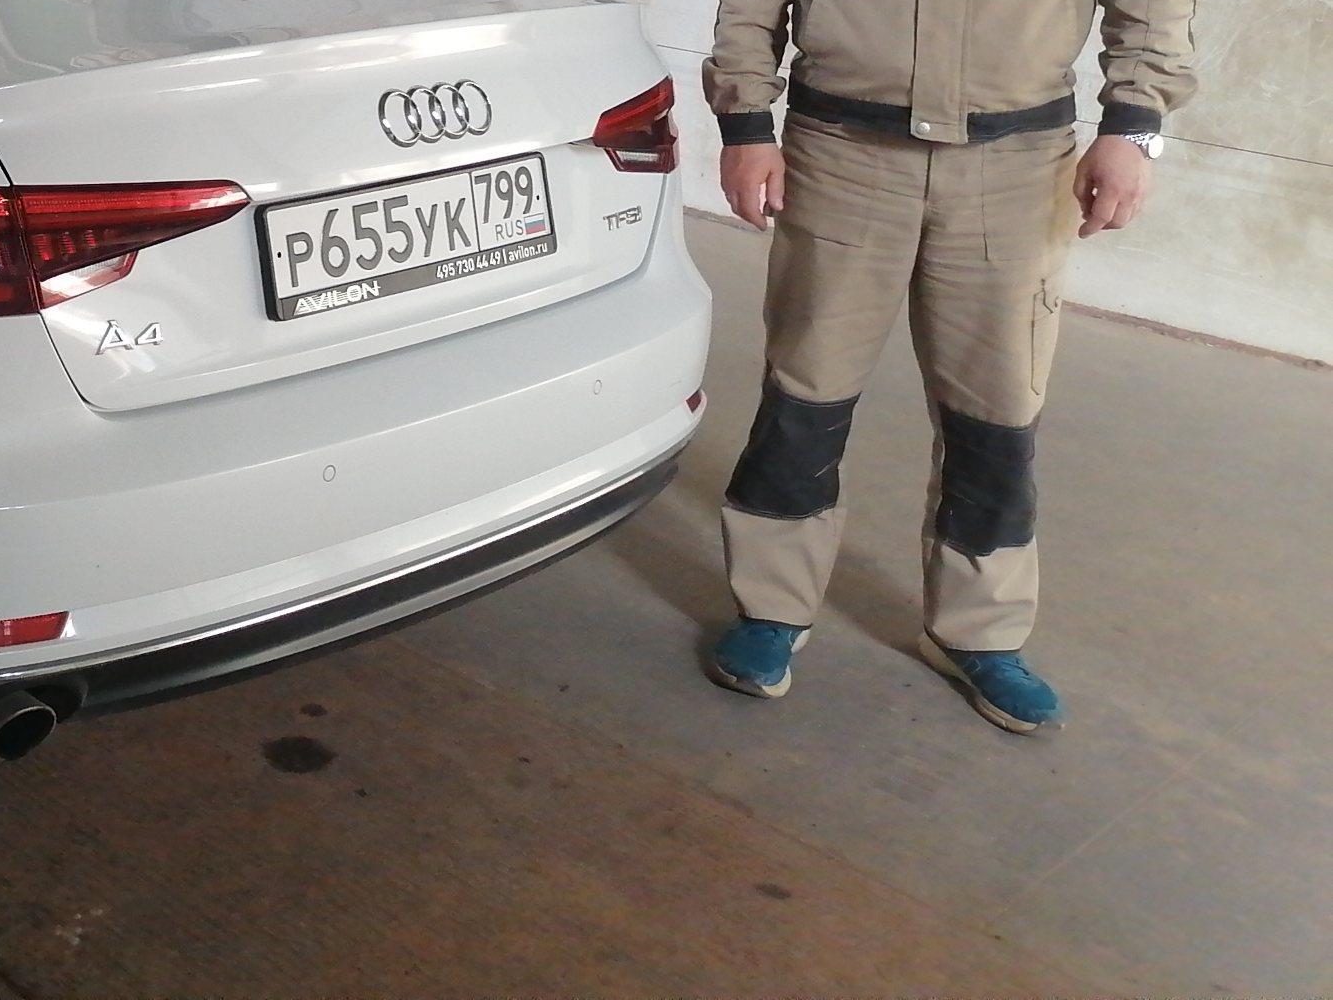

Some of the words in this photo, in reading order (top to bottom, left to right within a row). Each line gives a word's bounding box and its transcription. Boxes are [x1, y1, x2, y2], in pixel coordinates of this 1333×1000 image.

[285, 195, 472, 287] Р655УК
[474, 166, 533, 224] 799
[495, 219, 524, 242] RUS
[436, 264, 456, 279] 495
[455, 258, 475, 274] 730
[476, 255, 489, 269] 44
[489, 251, 501, 266] 49
[508, 242, 548, 262] avilon.ru
[293, 280, 382, 316] AVILON
[95, 319, 164, 355] A4
